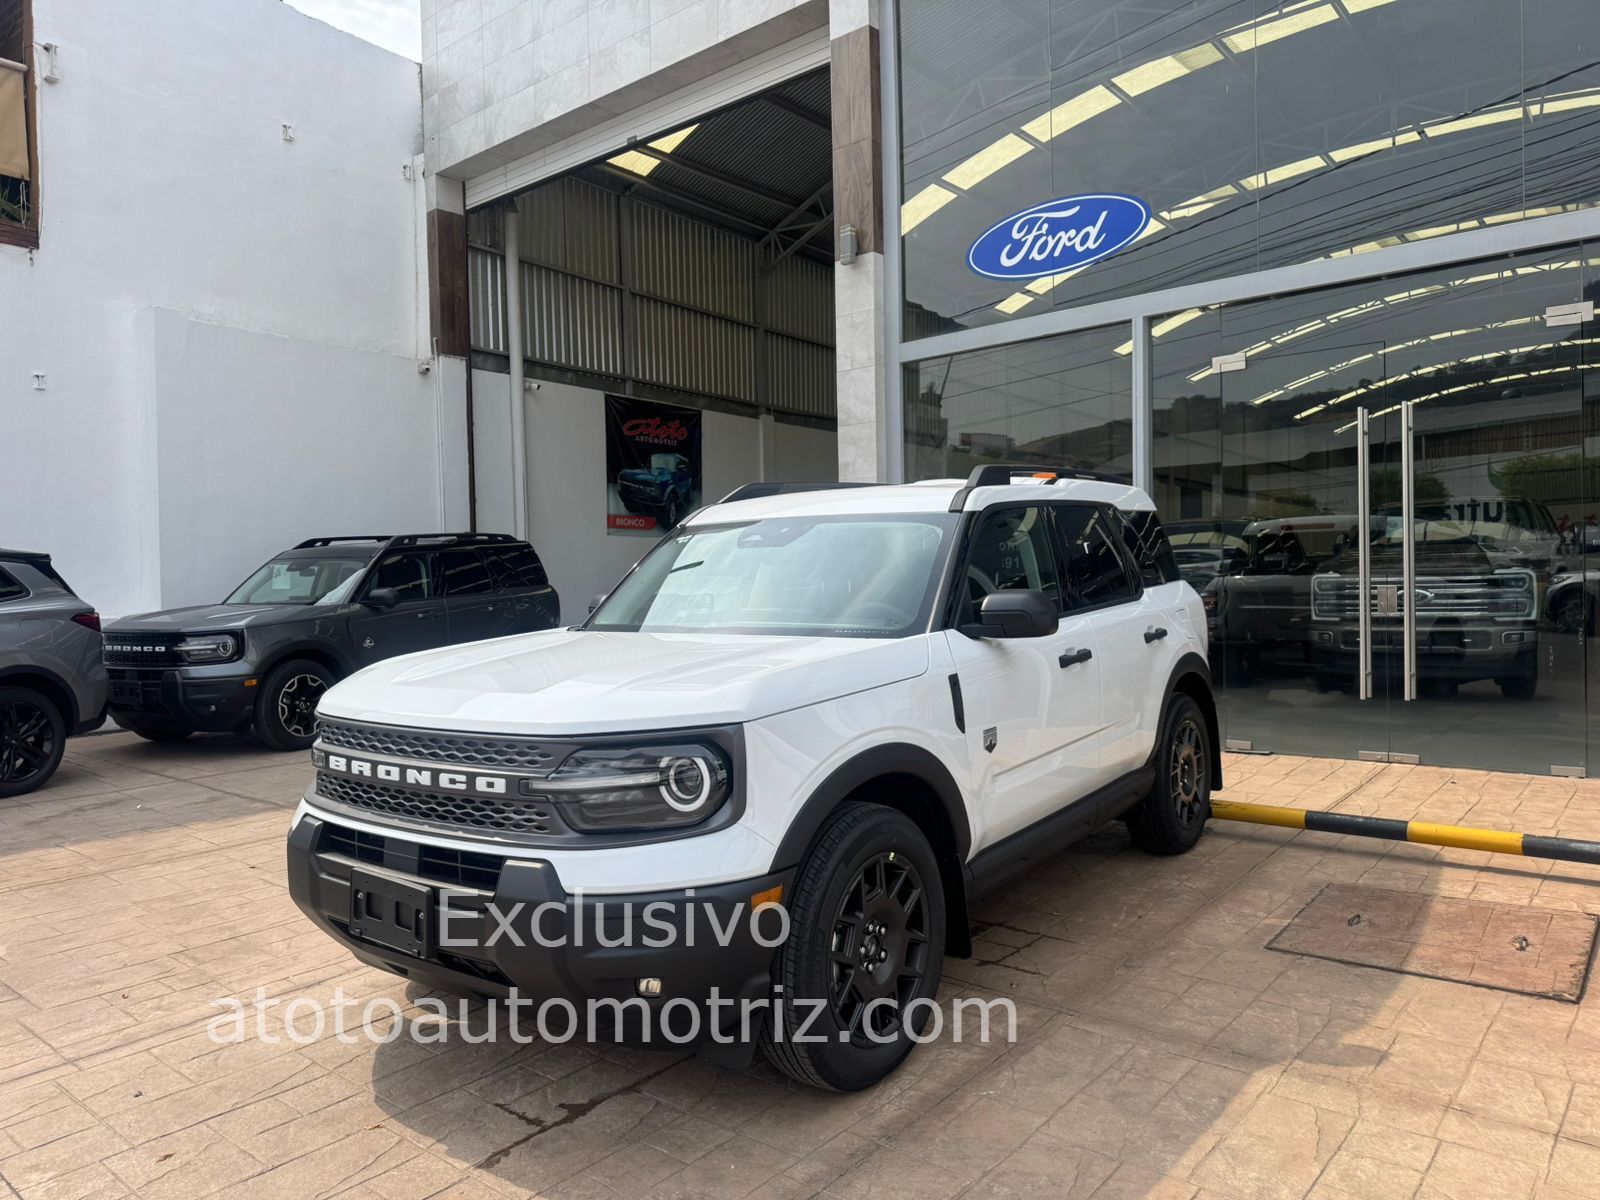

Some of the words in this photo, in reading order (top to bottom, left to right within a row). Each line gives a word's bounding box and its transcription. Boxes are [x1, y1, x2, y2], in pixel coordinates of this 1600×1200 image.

[1000, 205, 1108, 267] Ford
[615, 517, 645, 527] BRONCO
[329, 755, 506, 794] BRONCO
